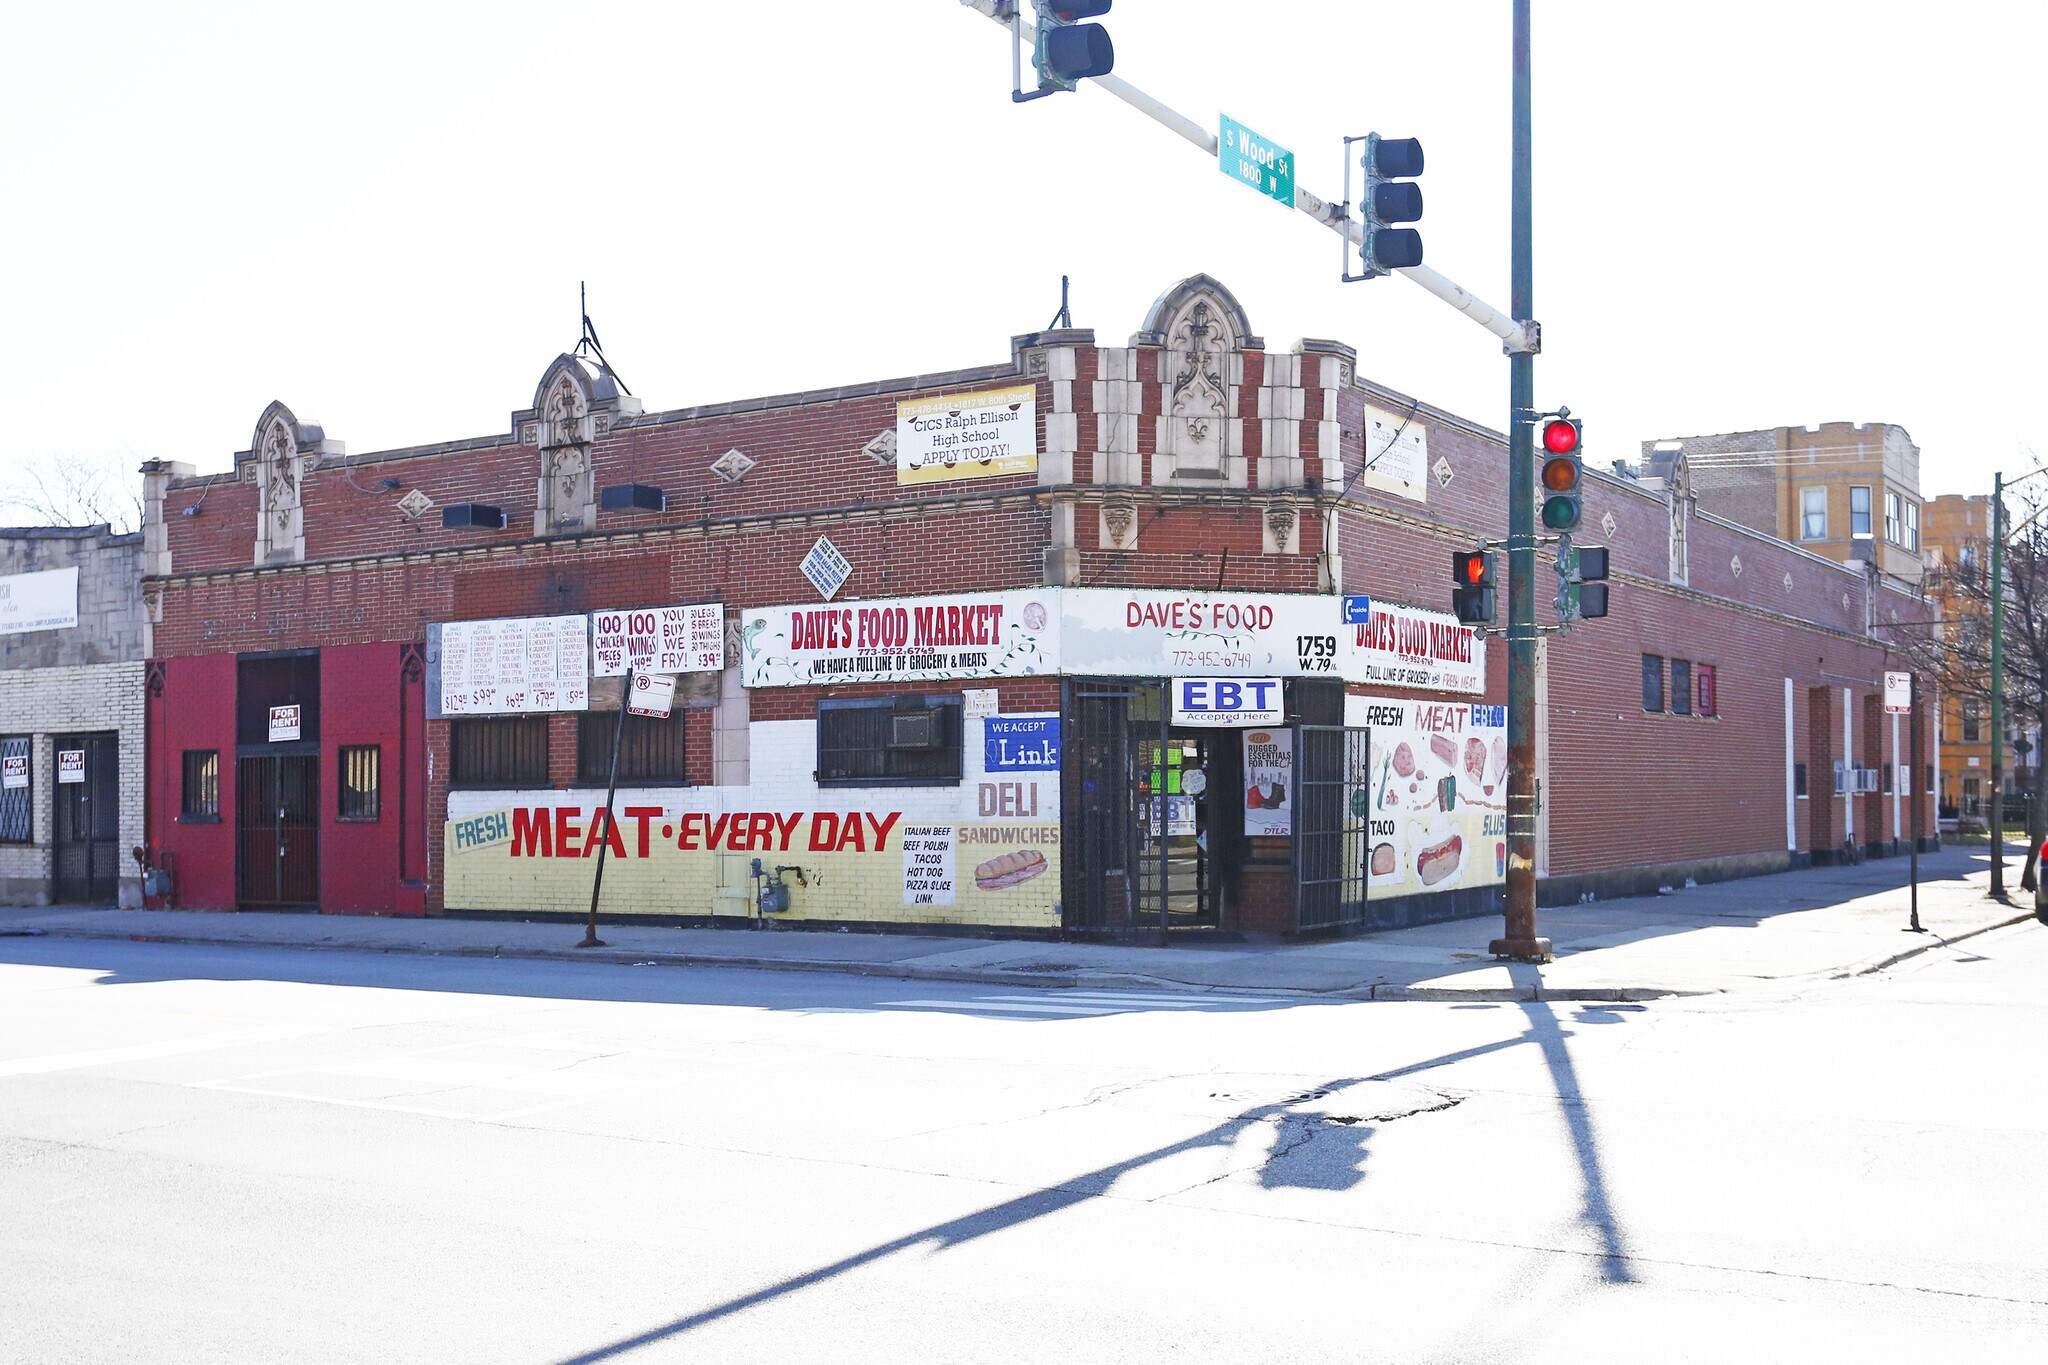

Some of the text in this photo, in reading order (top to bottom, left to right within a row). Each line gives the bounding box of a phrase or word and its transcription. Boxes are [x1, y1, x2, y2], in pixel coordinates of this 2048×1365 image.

[1227, 129, 1288, 177] S Wood St
[1239, 159, 1277, 192] 1800 W
[989, 394, 1006, 404] 80th
[1008, 392, 1030, 402] Street
[914, 412, 1018, 432] CICS Ralph Ellison
[932, 428, 1000, 448] High School
[922, 444, 1010, 464] APPLY TODAY!
[662, 610, 684, 622] YOU
[698, 608, 715, 618] LEGS
[1127, 598, 1274, 630] DAVE'S FOOD
[599, 616, 620, 634] 100
[628, 614, 656, 635] 100
[664, 624, 685, 636] BUY
[692, 619, 720, 629] 5 BREAST
[792, 605, 1003, 650] DAVE'S FOOD MARKET
[698, 630, 720, 640] WINGS
[1356, 611, 1472, 663] DAVE'S FOOD MARKET
[596, 635, 624, 650] CHICKEN
[628, 636, 656, 656] WINGS
[664, 637, 684, 650] WE
[699, 641, 720, 650] THIGHS
[1296, 636, 1336, 657] 1759
[598, 650, 621, 661] PIECES
[858, 646, 935, 656] 773-952-6749
[662, 652, 688, 668] FRY!
[814, 652, 988, 674] WE HAVE A FULL LINE OF GROCERY & MEATS
[1172, 651, 1251, 668] 773-952-6749
[1300, 658, 1314, 671] W.
[1398, 654, 1434, 666] 773-952-6749
[1366, 665, 1381, 680] FULL
[1383, 666, 1396, 681] LINE
[1398, 669, 1406, 682] OF
[1406, 669, 1432, 684] GROCERY
[1443, 673, 1460, 688] FRESH
[1460, 676, 1476, 689] MEAT
[1183, 682, 1276, 710] EBT
[275, 709, 294, 718] FOR
[1187, 712, 1270, 721] Accepted Here
[1366, 705, 1468, 732] FRESH MEAT
[272, 717, 297, 728] RENT
[992, 722, 1046, 732] WE ACCEPT
[64, 753, 79, 762] FOR
[999, 739, 1056, 764] Link
[1249, 752, 1291, 760] ESSENTIALS
[8, 759, 23, 768] FOR
[62, 762, 82, 770] RENT
[6, 767, 26, 776] RENT
[978, 782, 1038, 816] DELI
[456, 812, 508, 849] FRESH
[510, 807, 902, 858] MEAT EVERY DAY
[904, 827, 951, 836] ITALIAN BEEF
[1370, 820, 1394, 836] TACO
[958, 827, 1059, 844] SANDWICHES
[903, 841, 948, 851] BEEF POLISH
[914, 854, 942, 864] TACOS
[907, 868, 943, 878] HOT DOG
[906, 881, 952, 890] PIZZA SLICE
[915, 894, 933, 904] LINK
